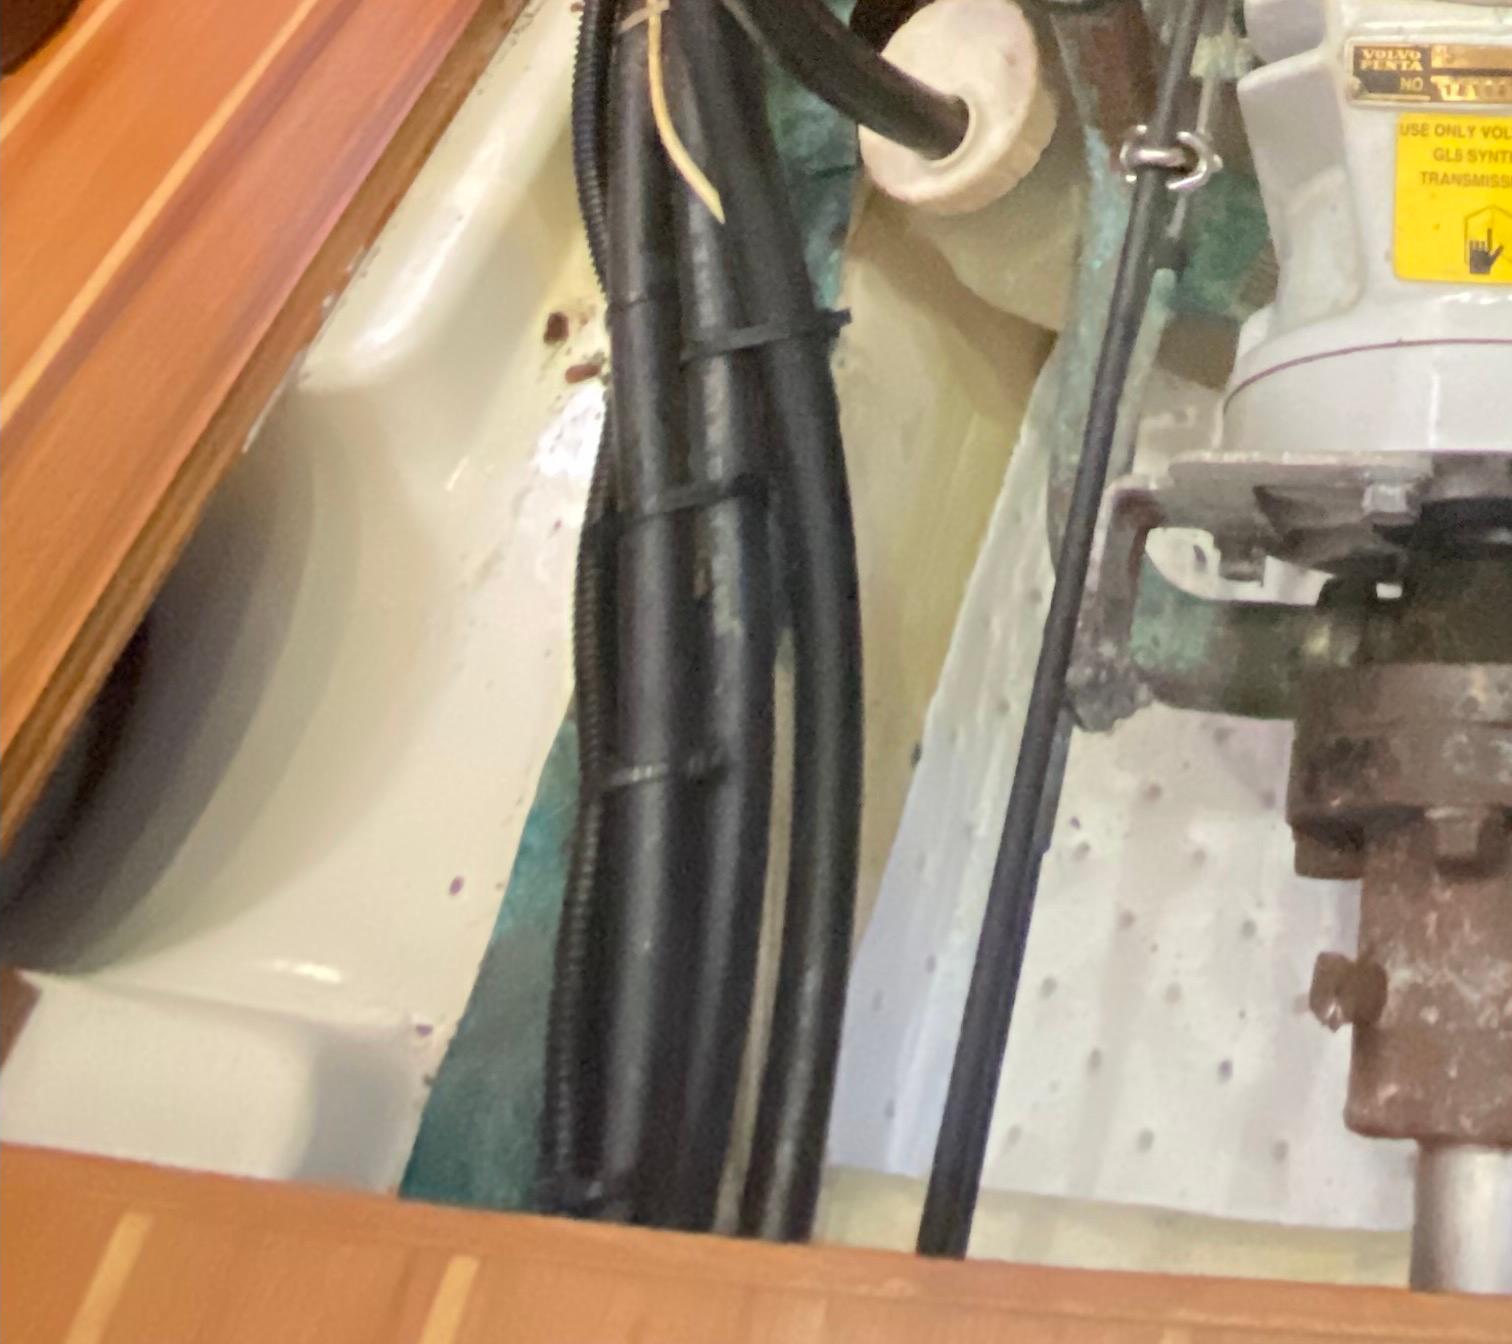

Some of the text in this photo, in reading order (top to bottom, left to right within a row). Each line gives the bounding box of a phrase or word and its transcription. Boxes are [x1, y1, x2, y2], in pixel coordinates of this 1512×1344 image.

[1360, 48, 1422, 60] VOLVO
[1359, 59, 1424, 72] PENTA
[1399, 122, 1430, 137] USE
[1433, 123, 1477, 139] ONLY
